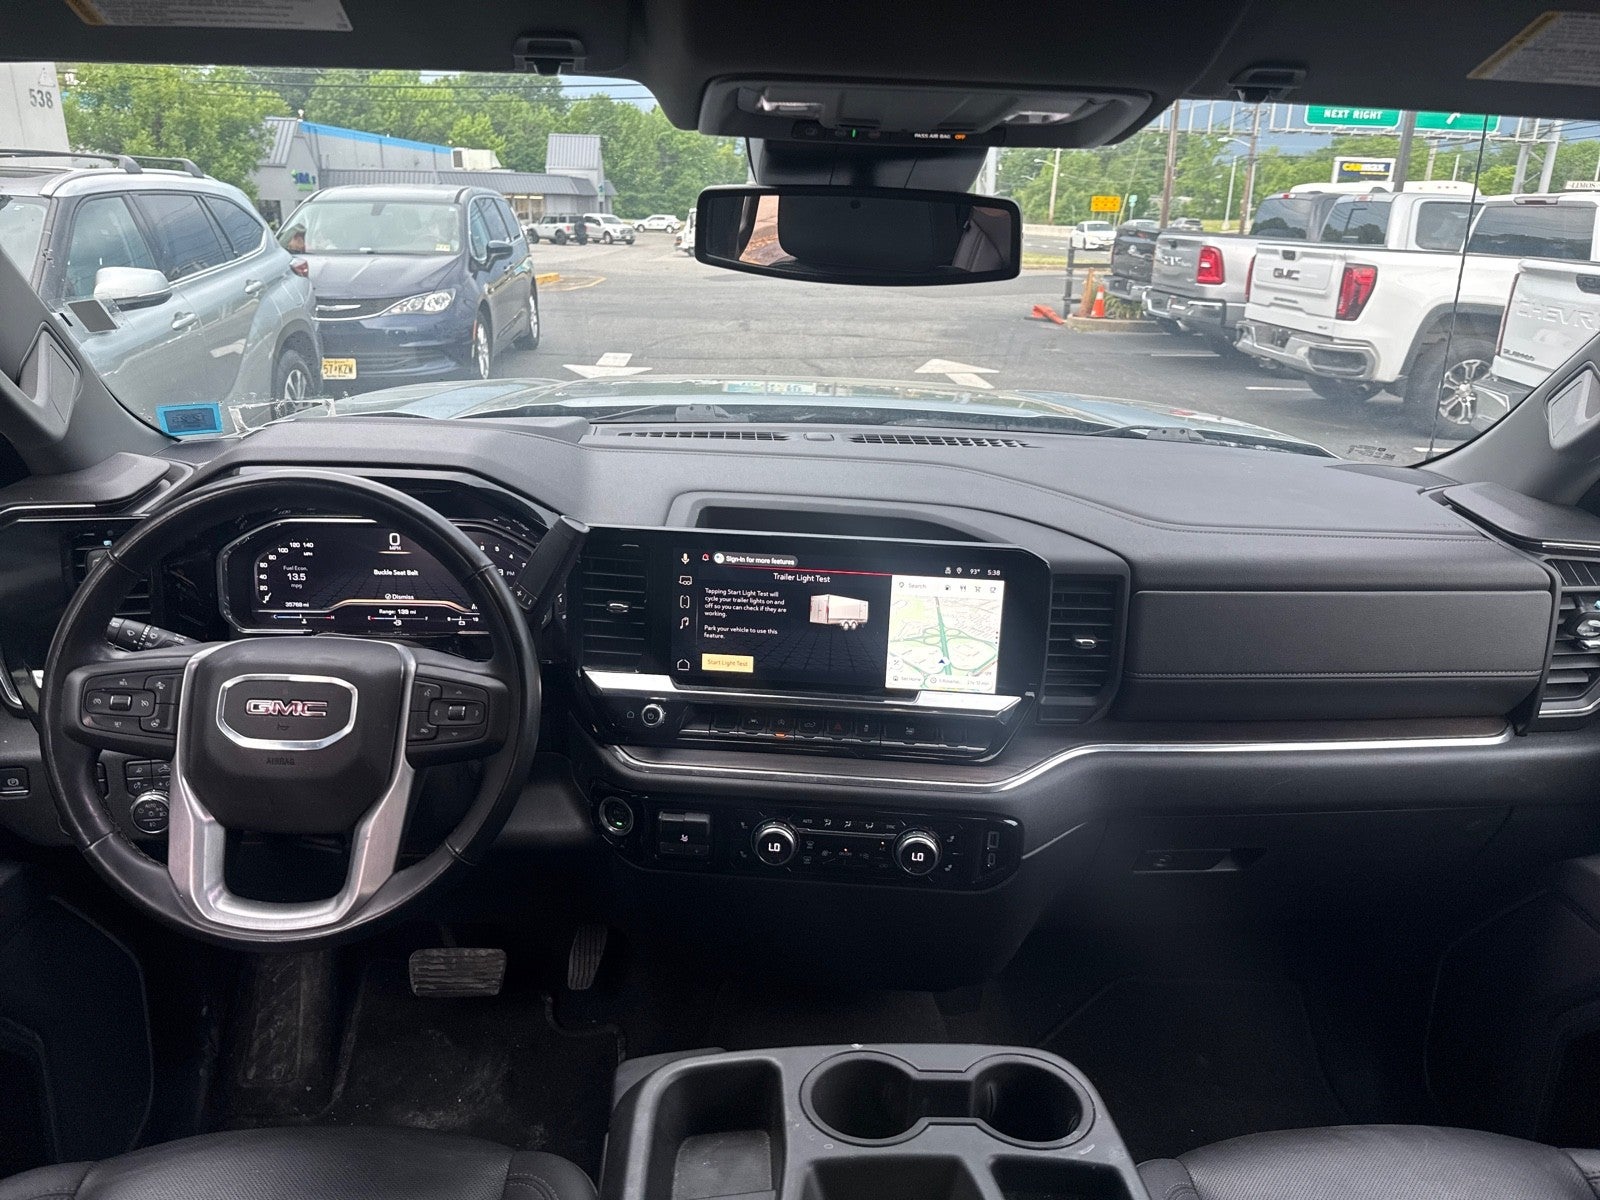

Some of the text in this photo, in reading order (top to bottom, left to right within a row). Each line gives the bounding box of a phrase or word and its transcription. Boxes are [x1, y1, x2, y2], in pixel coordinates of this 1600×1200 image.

[29, 88, 54, 109] 538
[1323, 109, 1383, 120] NEXT RIGHT
[1273, 267, 1300, 281] GMC
[389, 532, 401, 546] 0
[726, 555, 746, 564] Sign-in
[771, 557, 795, 566] features
[287, 573, 307, 581] 13.5
[773, 572, 831, 584] Trailer Light Test
[704, 587, 727, 596] Tapping
[742, 590, 756, 598] Light
[704, 610, 727, 618] working.
[764, 606, 777, 614] they
[721, 659, 736, 667] Light
[245, 699, 328, 717] GMC
[266, 757, 295, 765] AIRBAG
